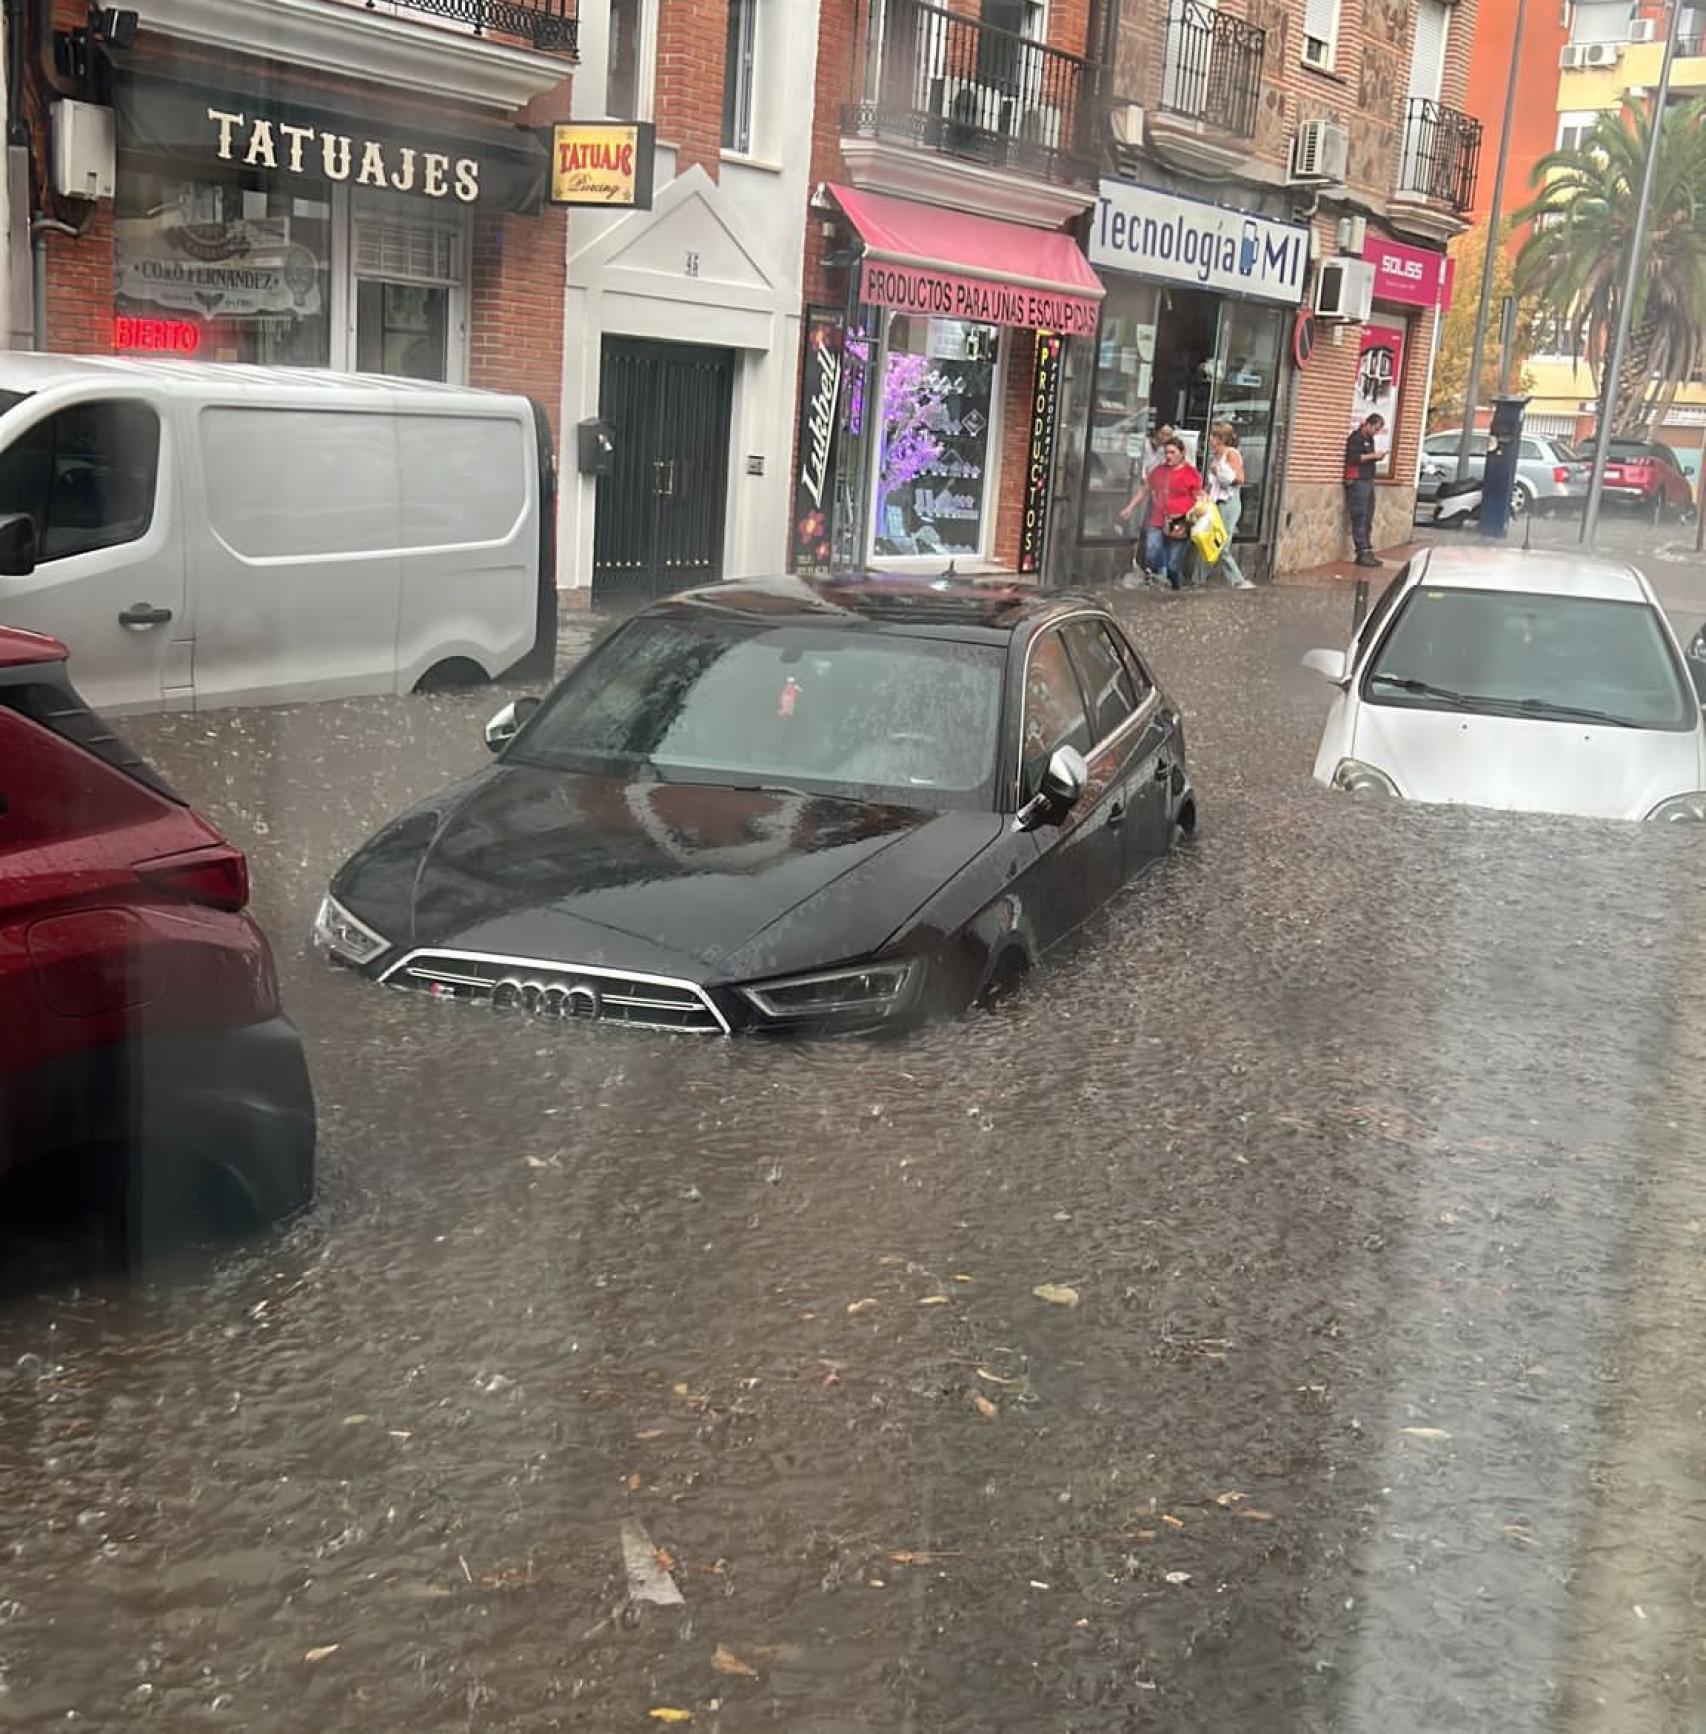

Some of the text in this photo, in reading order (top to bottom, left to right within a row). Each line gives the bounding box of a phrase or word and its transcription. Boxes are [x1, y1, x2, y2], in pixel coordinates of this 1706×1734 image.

[207, 108, 479, 202] TATUAJES
[1099, 197, 1301, 286] Tecnología MI
[868, 269, 952, 312] PRODUCTOS
[957, 285, 989, 316] PARA
[991, 285, 1024, 324] UÑAS
[1024, 347, 1049, 550] PRODUCTOS
